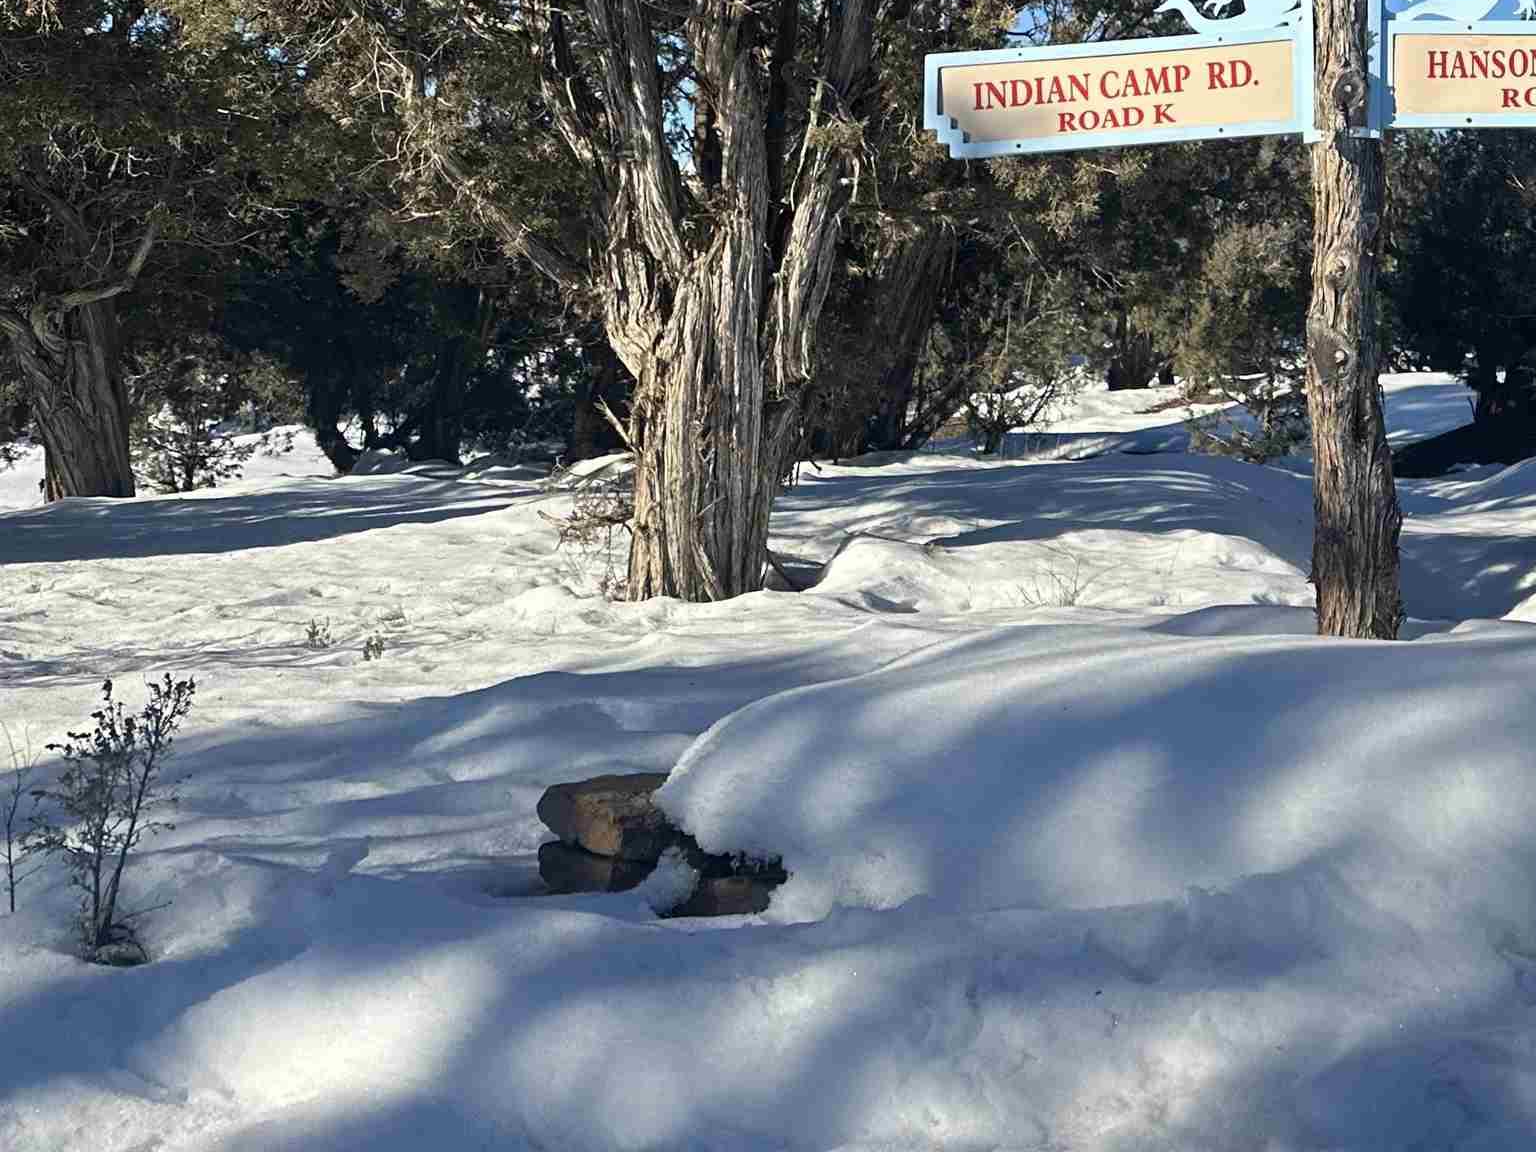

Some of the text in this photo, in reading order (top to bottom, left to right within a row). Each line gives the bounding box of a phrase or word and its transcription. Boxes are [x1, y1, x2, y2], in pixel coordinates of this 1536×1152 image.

[973, 59, 1260, 110] INDIAN CAMP RD.
[1056, 103, 1177, 133] ROAD K
